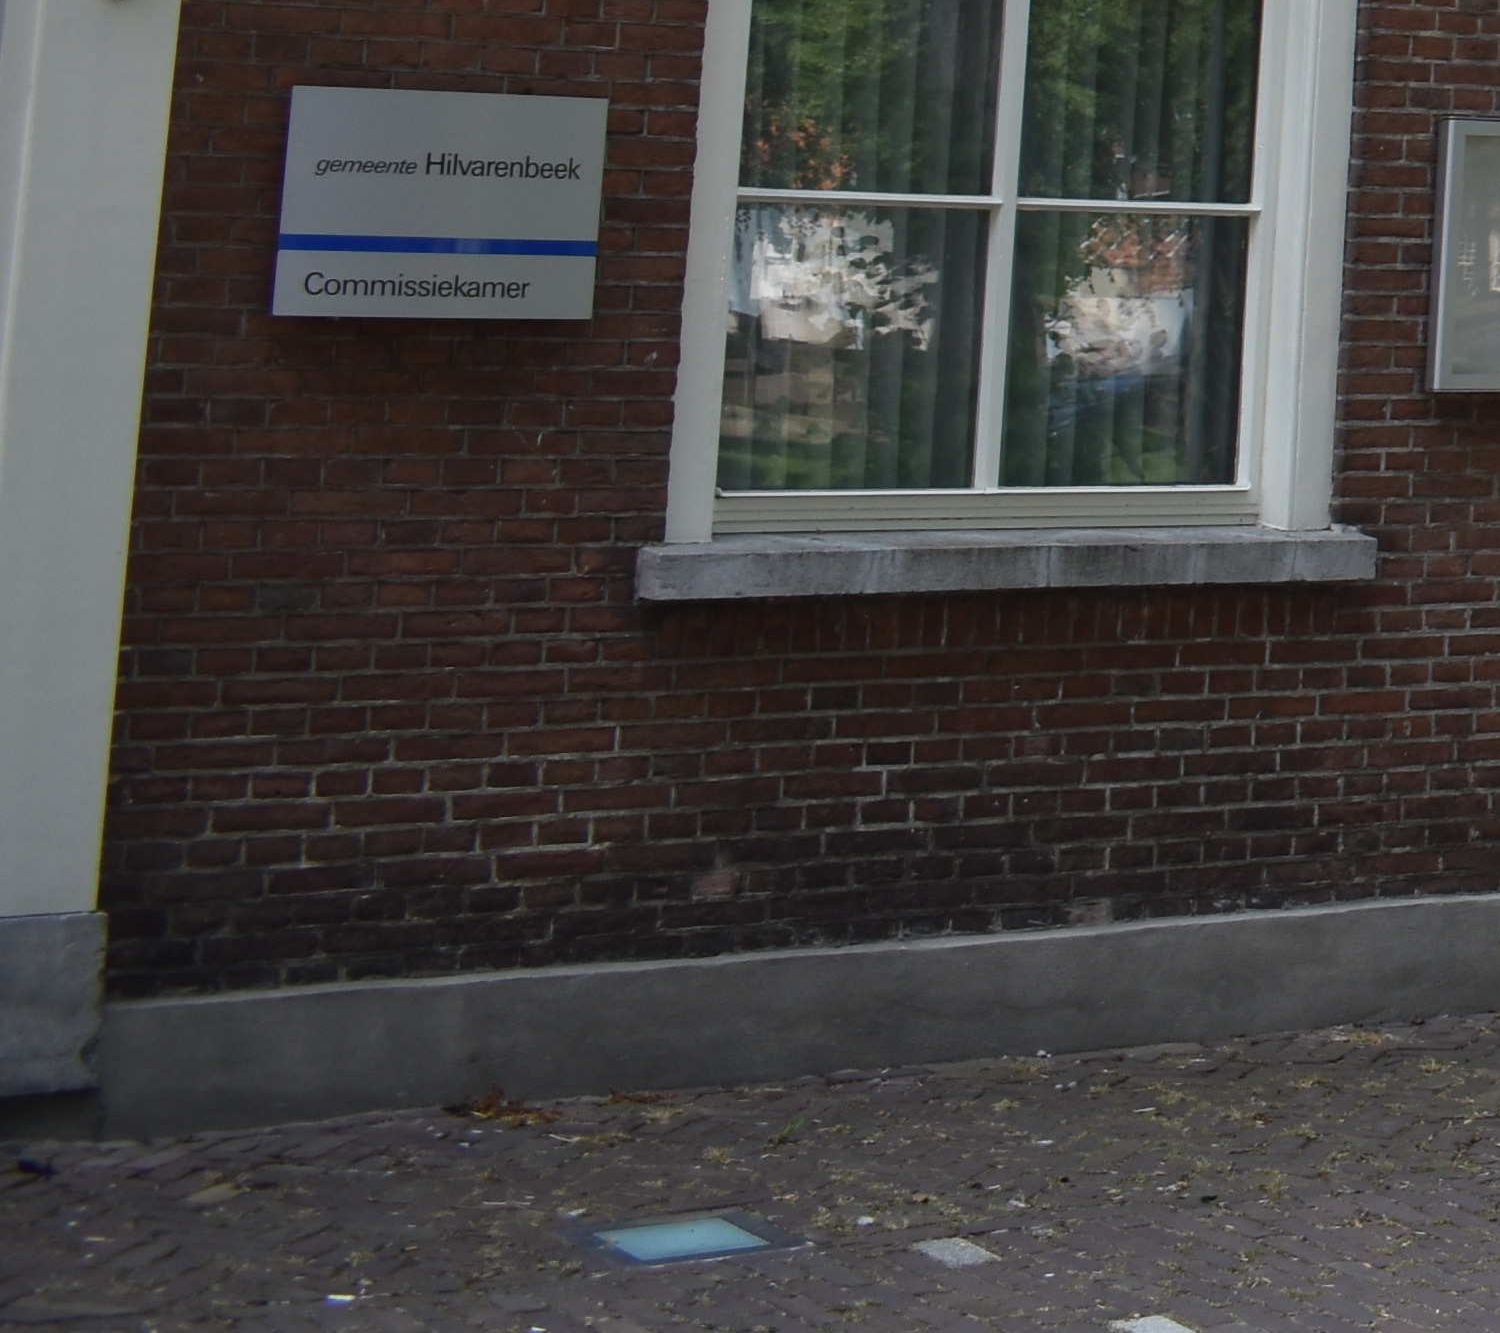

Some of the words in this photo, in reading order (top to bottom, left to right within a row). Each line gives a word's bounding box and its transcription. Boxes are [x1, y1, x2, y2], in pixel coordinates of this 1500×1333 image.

[314, 157, 418, 176] gemeente
[425, 152, 581, 180] Hilvarenbeek
[304, 271, 531, 299] Commissiekamer
